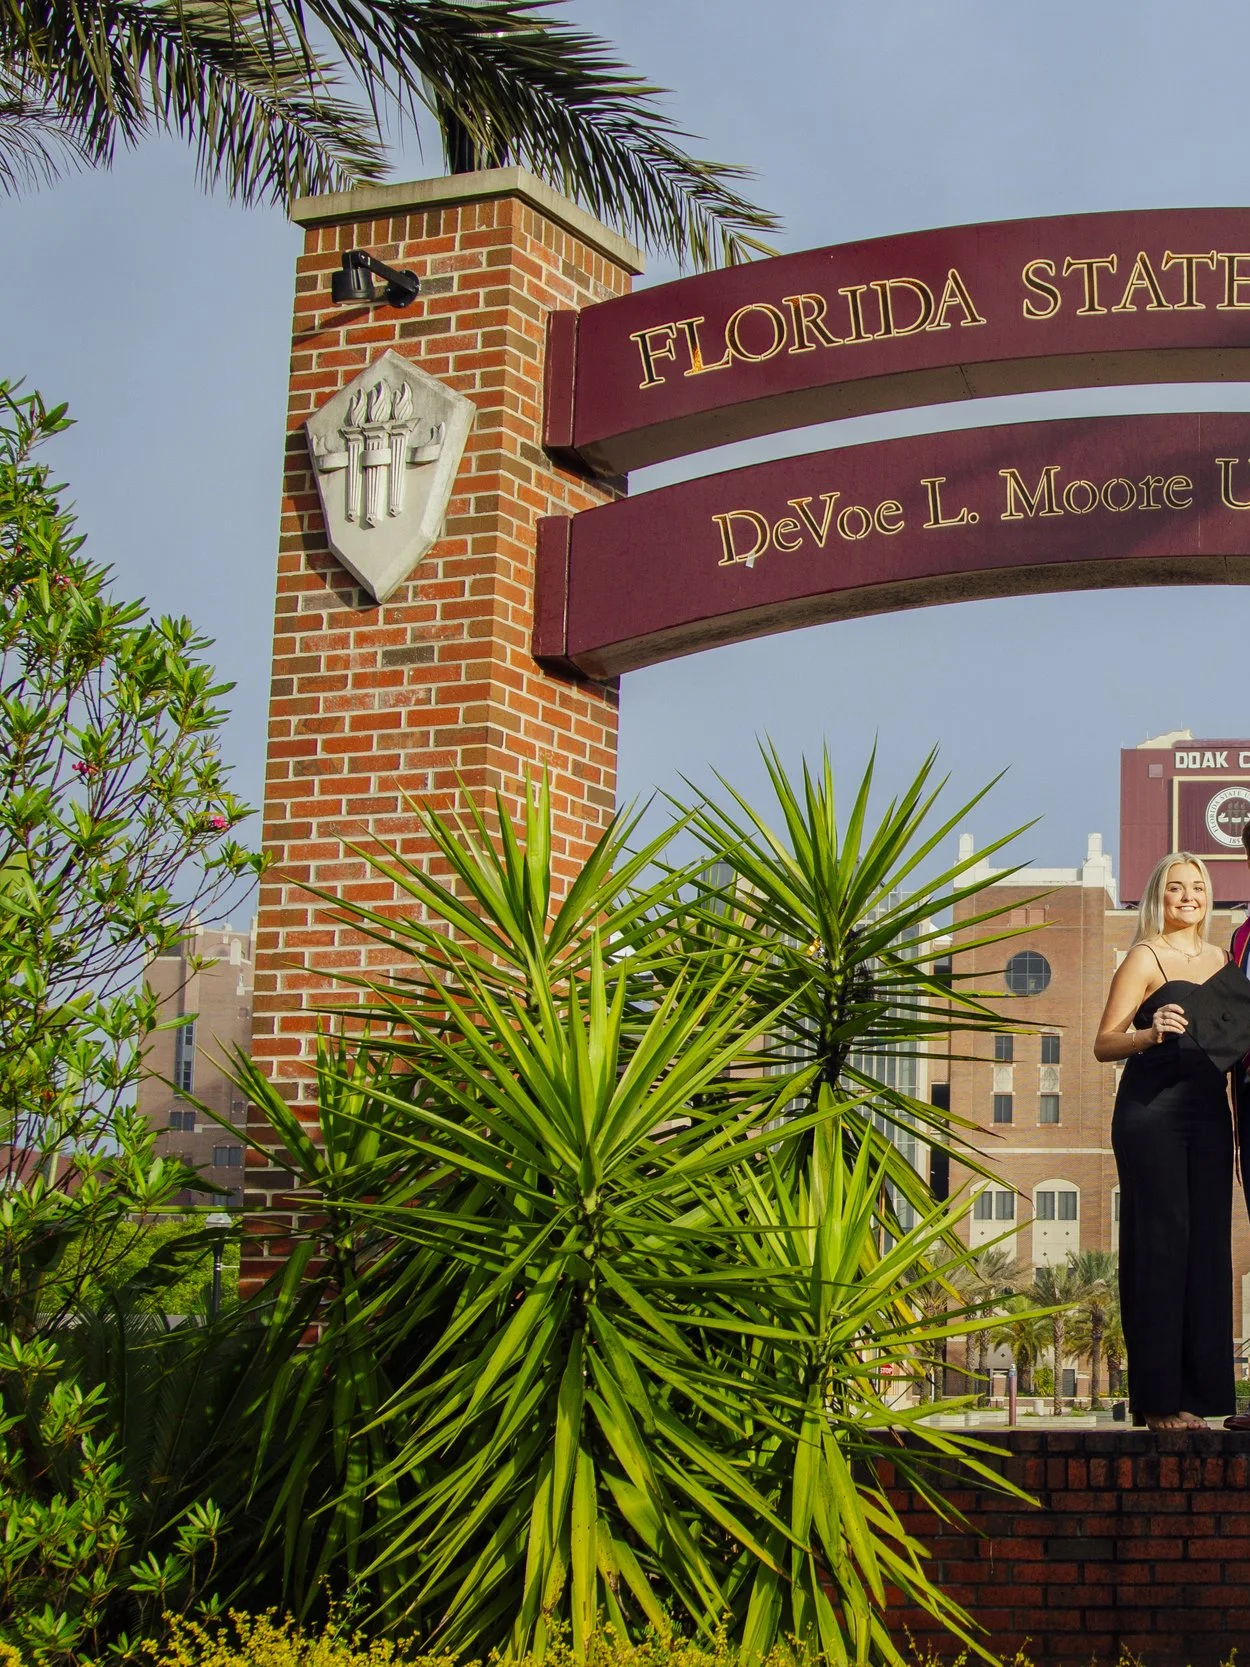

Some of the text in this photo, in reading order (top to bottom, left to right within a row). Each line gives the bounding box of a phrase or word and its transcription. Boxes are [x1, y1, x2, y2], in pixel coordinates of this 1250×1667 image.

[629, 268, 987, 389] FLORIDA
[711, 492, 905, 566] DeVoe
[921, 476, 979, 529] L.
[999, 465, 1194, 520] Moore
[1175, 751, 1229, 768] DOAK
[1209, 800, 1220, 833] FLORIDA
[1220, 790, 1241, 799] STATE
